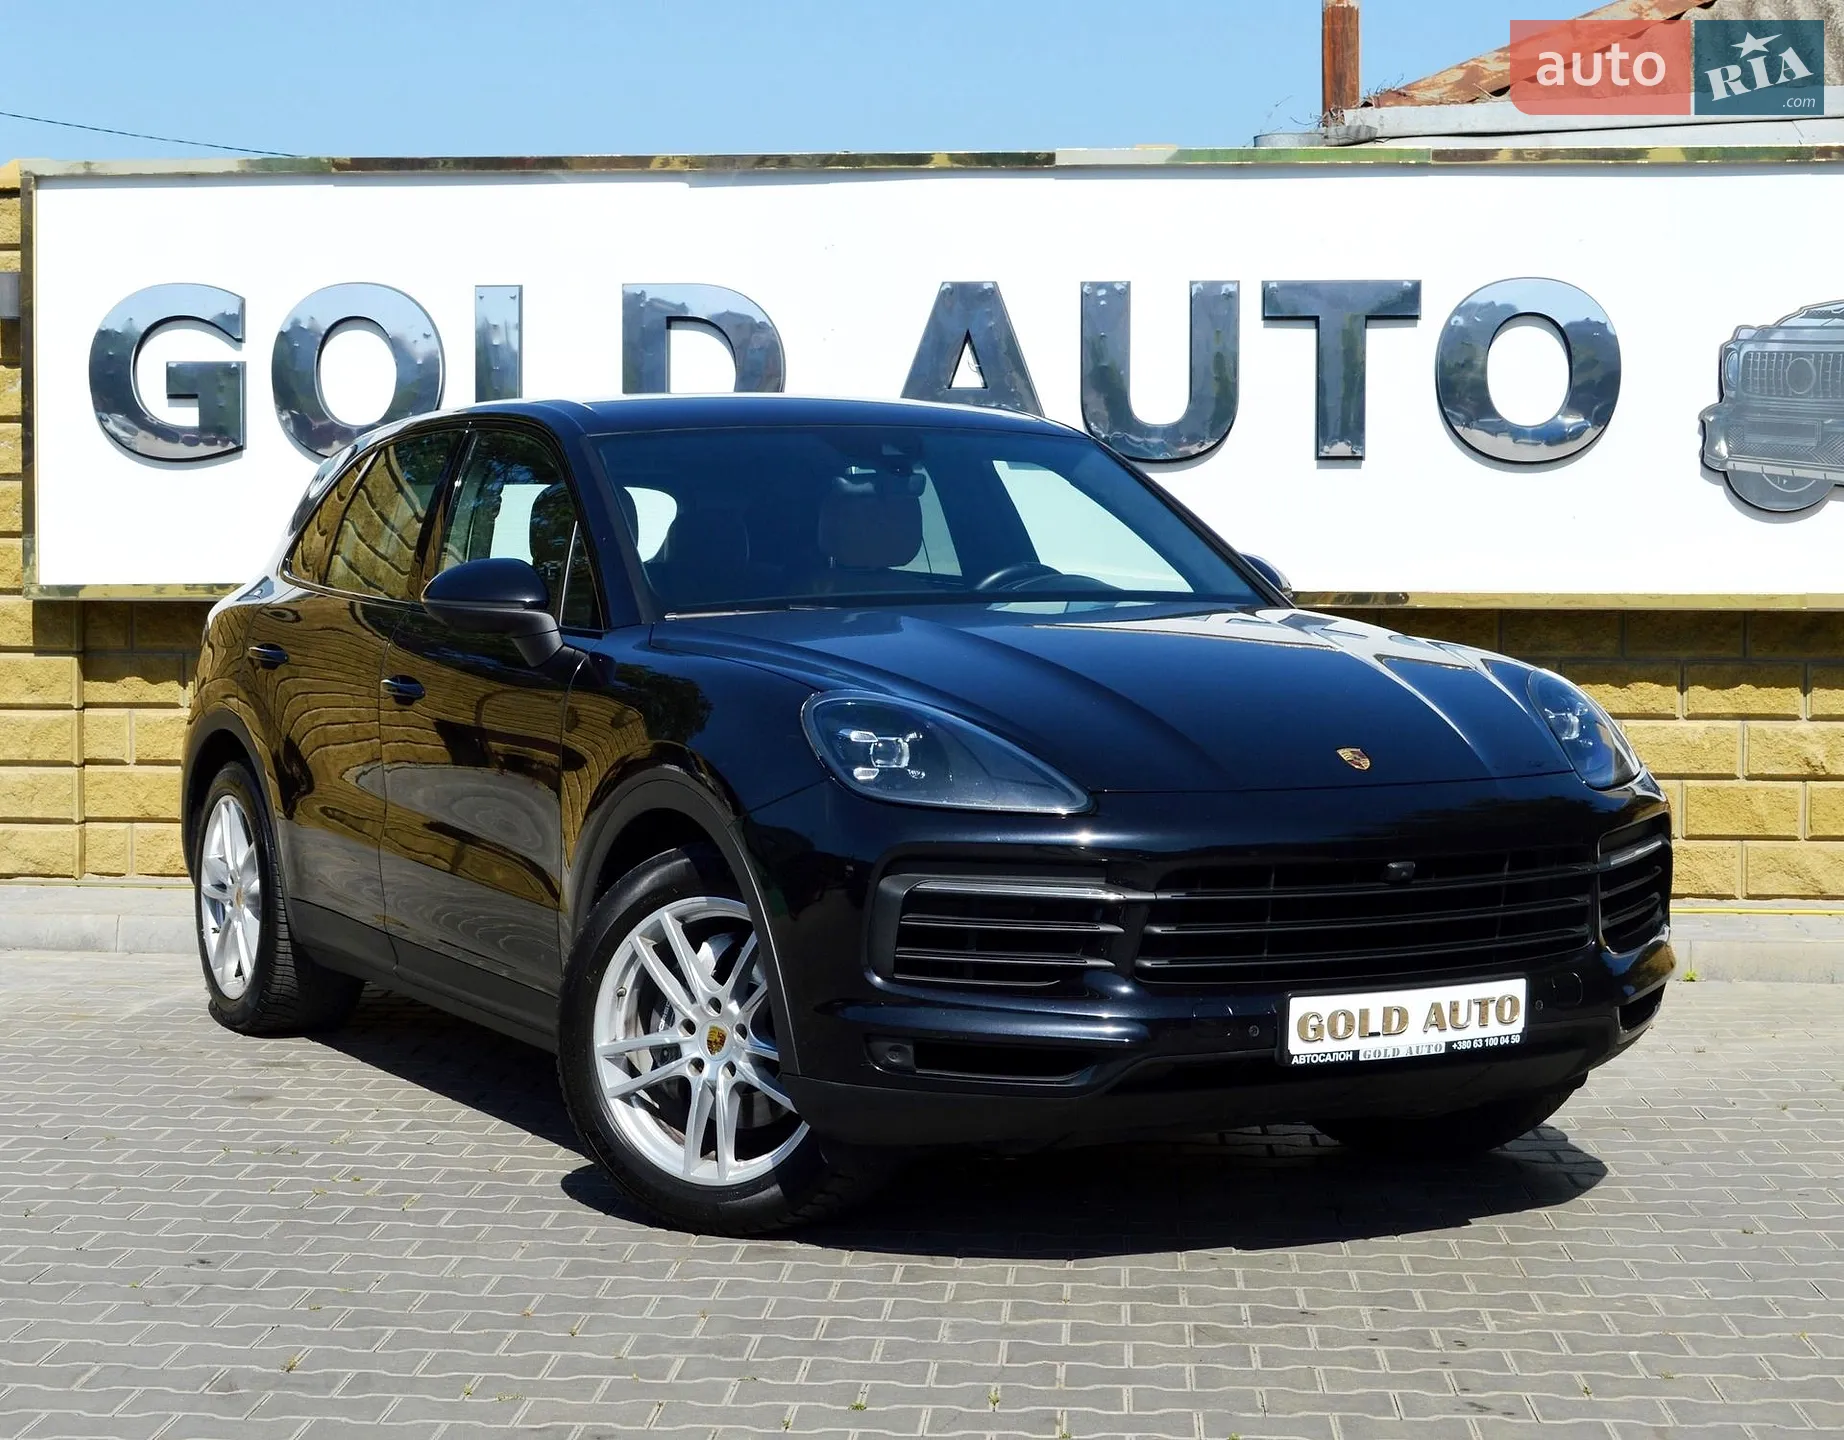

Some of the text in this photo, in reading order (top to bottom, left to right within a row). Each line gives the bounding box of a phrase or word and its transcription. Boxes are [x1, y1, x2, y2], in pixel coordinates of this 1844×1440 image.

[900, 277, 1622, 464] AUTO
[1296, 993, 1521, 1043] GOLD AUTO
[1452, 1034, 1521, 1051] +380 63 100 04 50
[1291, 1051, 1354, 1065] АВТОСАЛОН
[1363, 1043, 1444, 1060] GOLD AUTO
